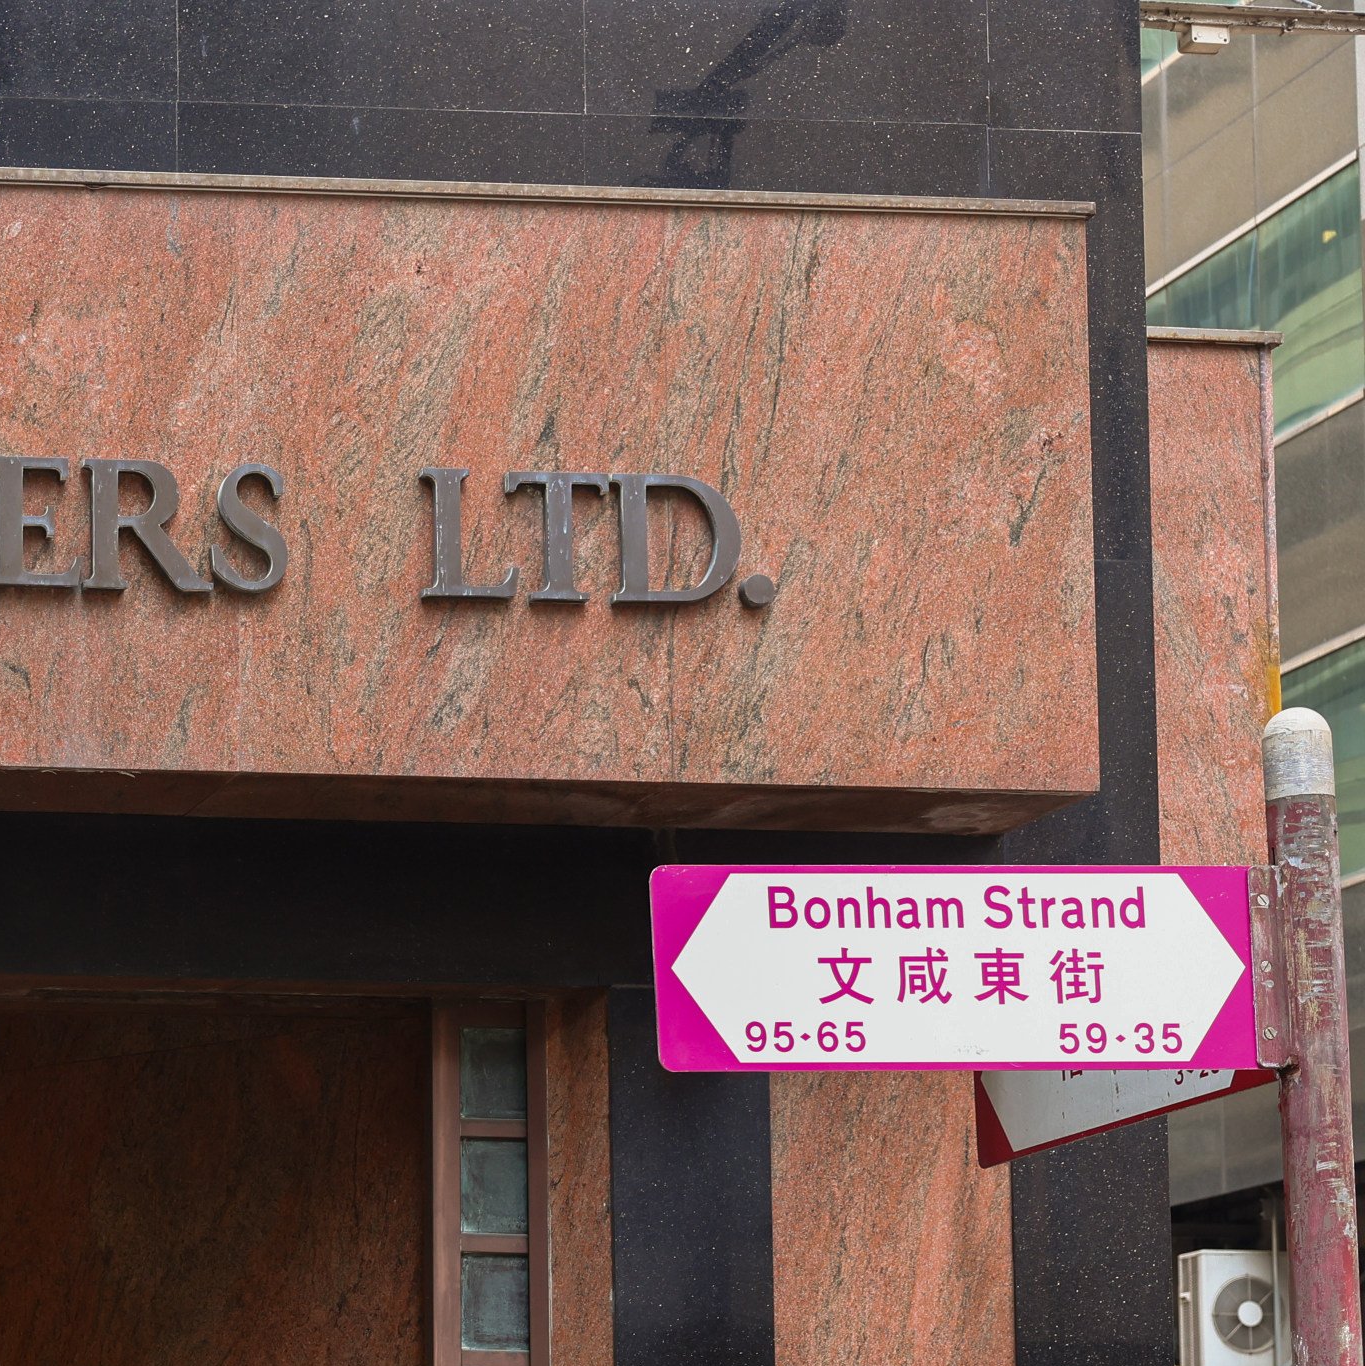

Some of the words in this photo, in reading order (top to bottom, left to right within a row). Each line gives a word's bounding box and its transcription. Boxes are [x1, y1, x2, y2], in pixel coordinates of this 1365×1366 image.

[418, 467, 774, 608] LTD.
[767, 885, 965, 930] Bonham
[982, 885, 1147, 930] Strand
[817, 946, 1106, 1006] 文咸東街
